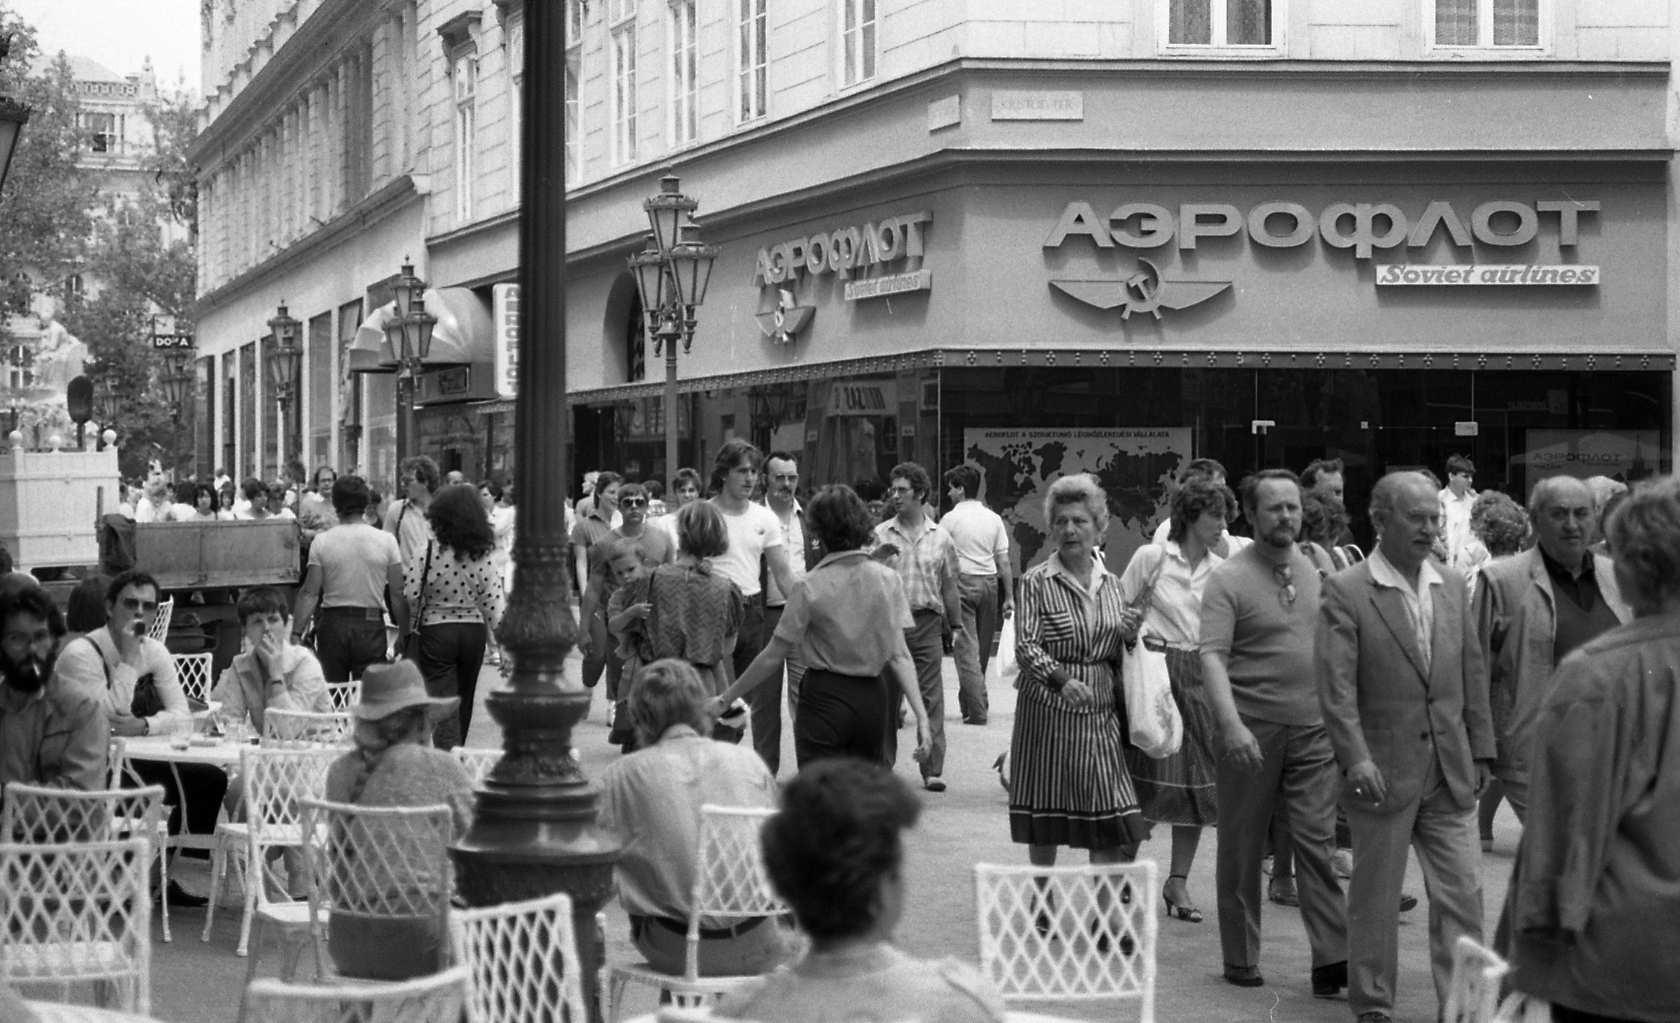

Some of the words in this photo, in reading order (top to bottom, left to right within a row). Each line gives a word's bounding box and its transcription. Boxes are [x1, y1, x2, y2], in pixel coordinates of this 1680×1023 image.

[1043, 201, 1601, 258] АЭРОФЛОТ
[755, 213, 931, 286] АЭРОФЛОТ
[1380, 264, 1474, 284] Soviet
[1481, 264, 1597, 284] airlines
[156, 337, 189, 347] DOA
